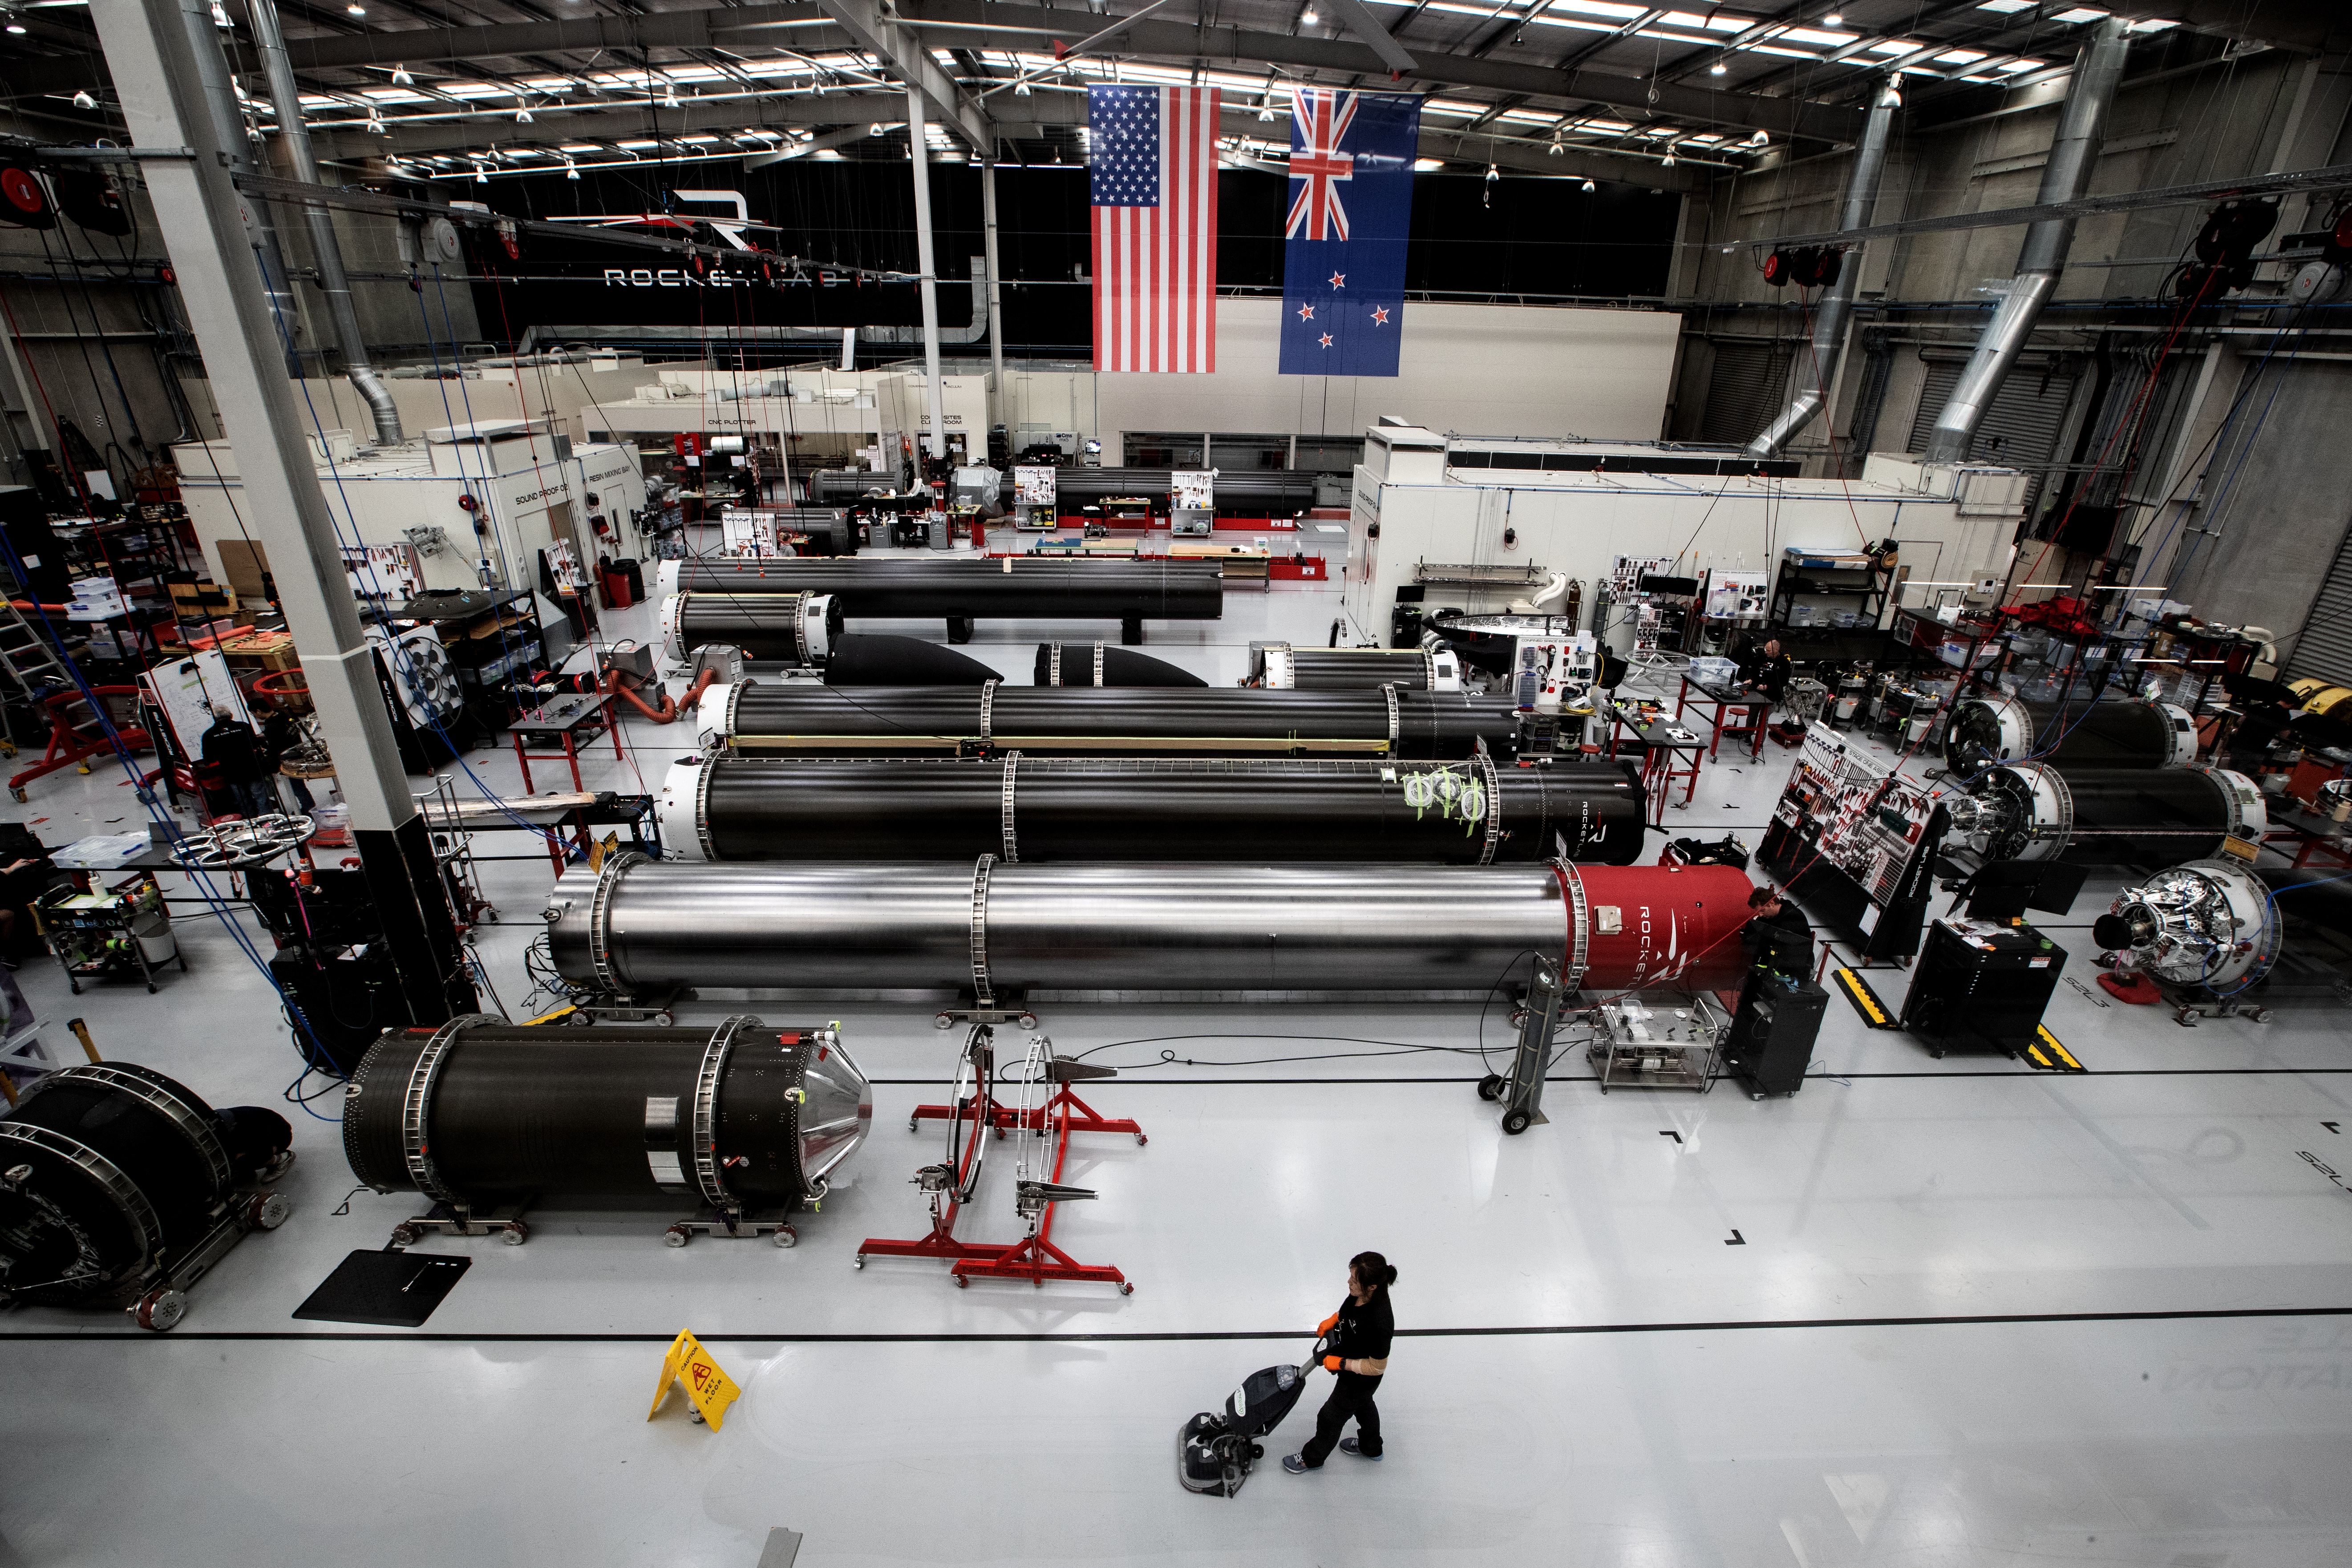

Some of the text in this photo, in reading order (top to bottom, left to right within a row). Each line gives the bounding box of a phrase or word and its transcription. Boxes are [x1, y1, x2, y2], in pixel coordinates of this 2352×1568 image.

[590, 466, 630, 482] RESIN MIXING BAY
[516, 493, 538, 505] SOUND
[539, 486, 559, 497] PROOF
[1849, 750, 1886, 776] STAGE ONE ASSY
[1579, 802, 1588, 843] ROCKET
[1908, 846, 1930, 897] ROCKET LAB
[1633, 906, 1651, 981] ROCKET
[2061, 977, 2110, 1007] S2L3
[2295, 1151, 2352, 1194] S2L
[681, 1346, 698, 1371] CAUTION
[704, 1378, 715, 1394] WET
[705, 1379, 722, 1405] FLOOR
